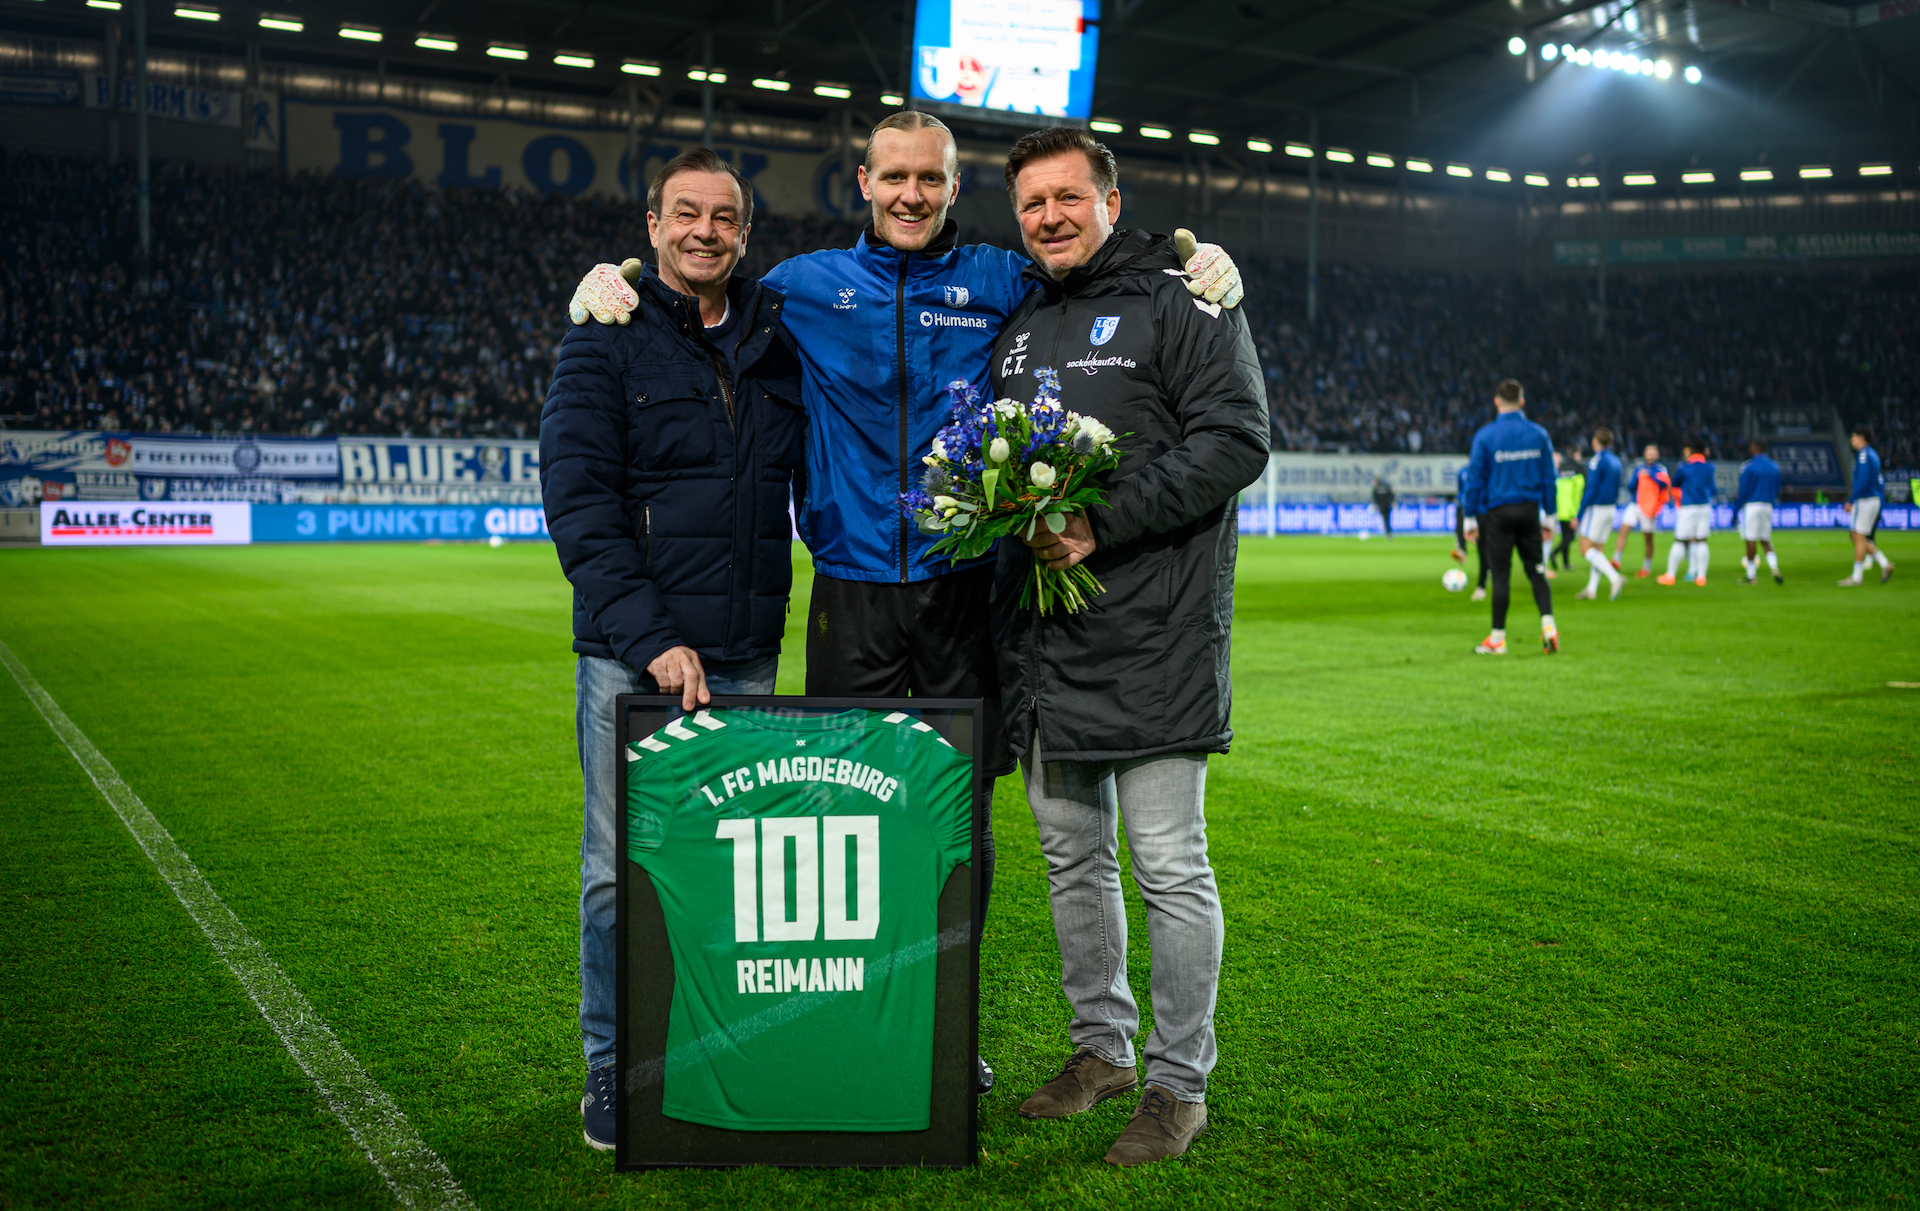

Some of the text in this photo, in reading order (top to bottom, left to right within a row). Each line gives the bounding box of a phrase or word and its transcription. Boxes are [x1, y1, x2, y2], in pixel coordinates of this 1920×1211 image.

[934, 312, 988, 329] Humanas
[1001, 354, 1028, 378] C.T.
[1066, 356, 1137, 369] sockenkauf24.de
[341, 444, 477, 483] BLUE
[296, 509, 317, 535] 3
[328, 509, 476, 535] PUNKTE?
[700, 756, 899, 807] 1. FC MAGDEBURG
[714, 815, 881, 943] 100
[736, 957, 865, 994] REIMANN
